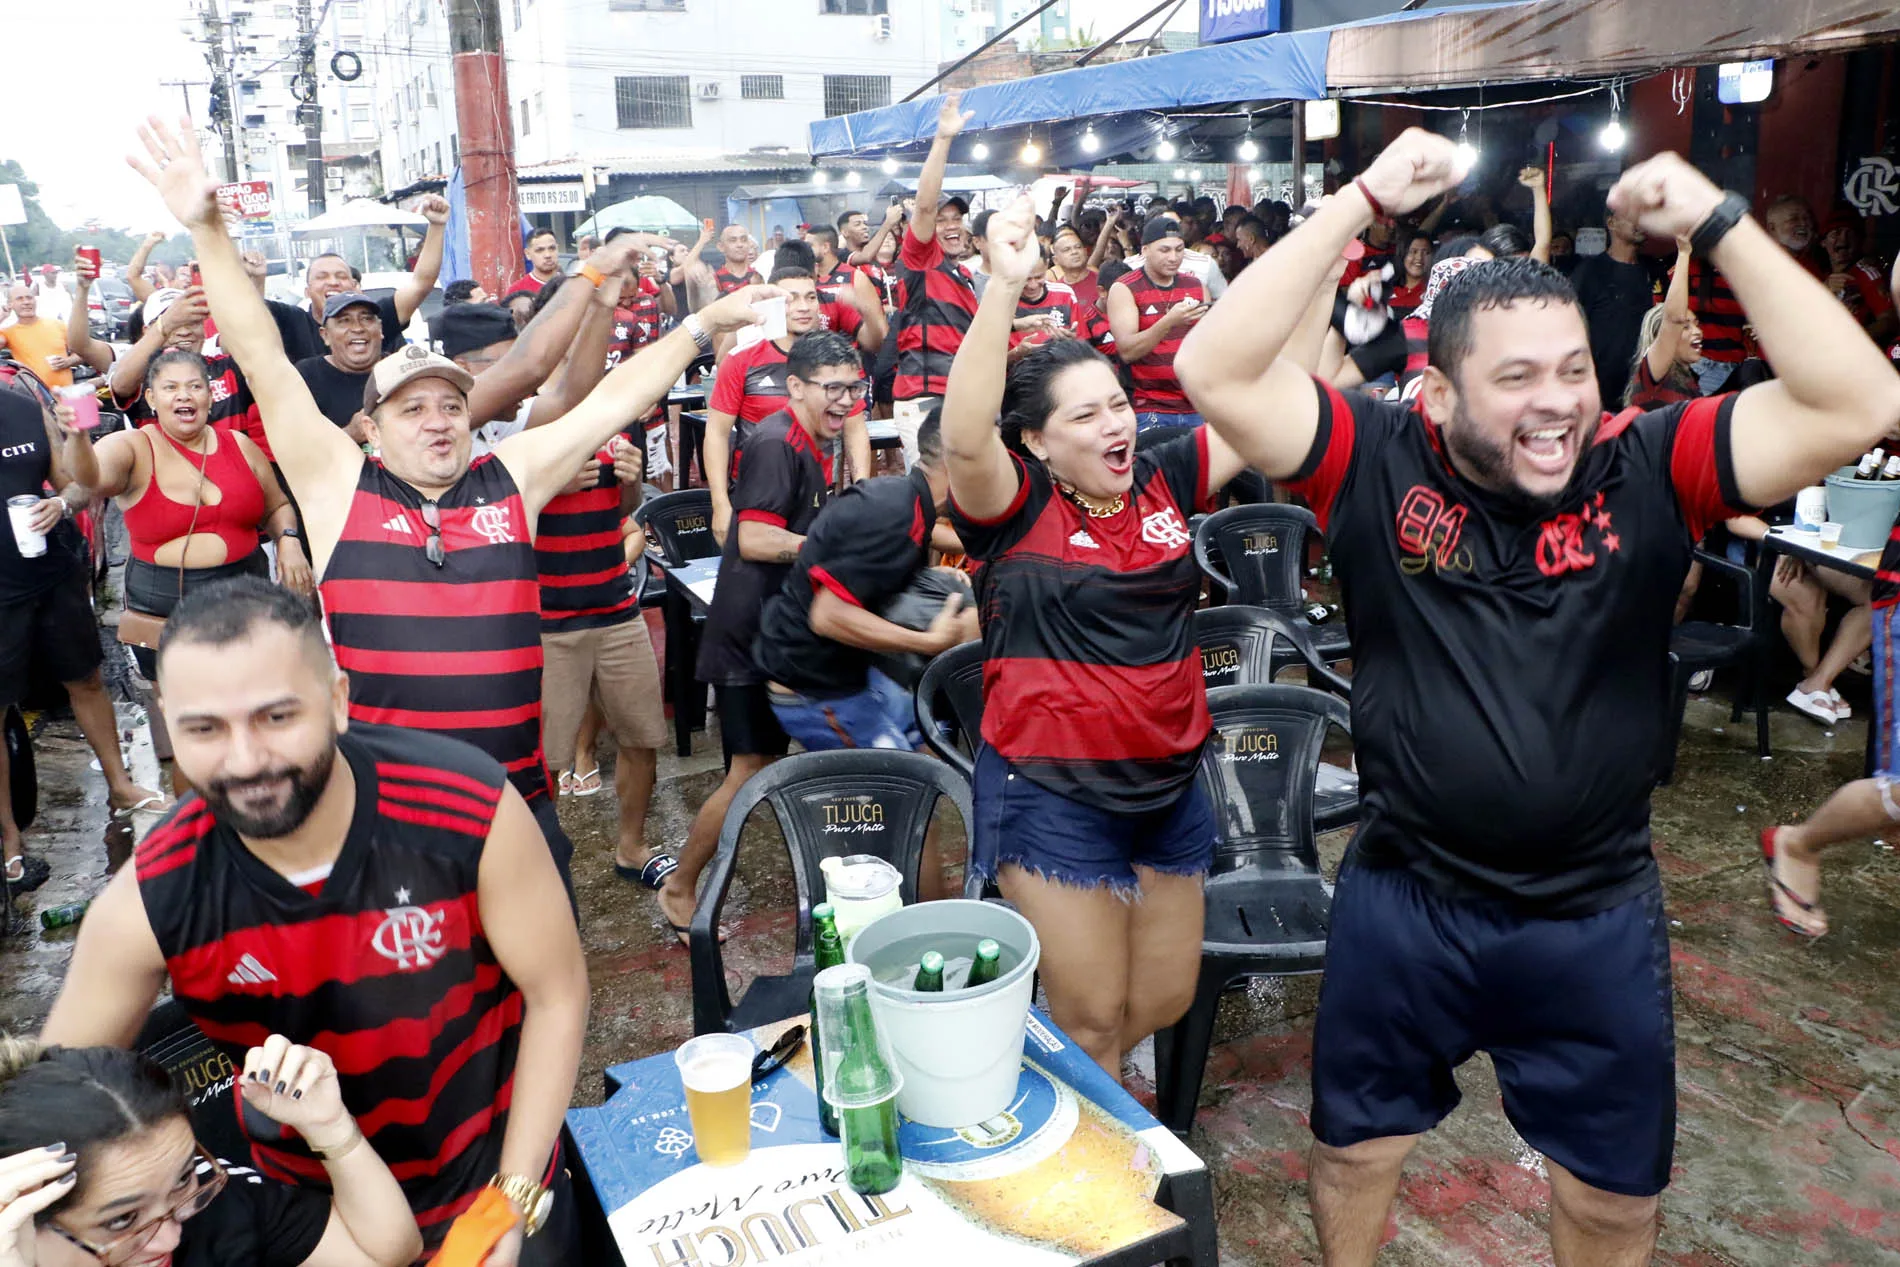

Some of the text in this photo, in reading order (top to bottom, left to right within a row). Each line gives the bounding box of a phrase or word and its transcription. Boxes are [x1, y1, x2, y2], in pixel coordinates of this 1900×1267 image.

[526, 191, 546, 205] FRITO
[1, 442, 35, 458] CITY
[1223, 734, 1278, 753] TIJUCA
[822, 803, 883, 824] TIJUCA
[821, 823, 887, 835] Puro Malte
